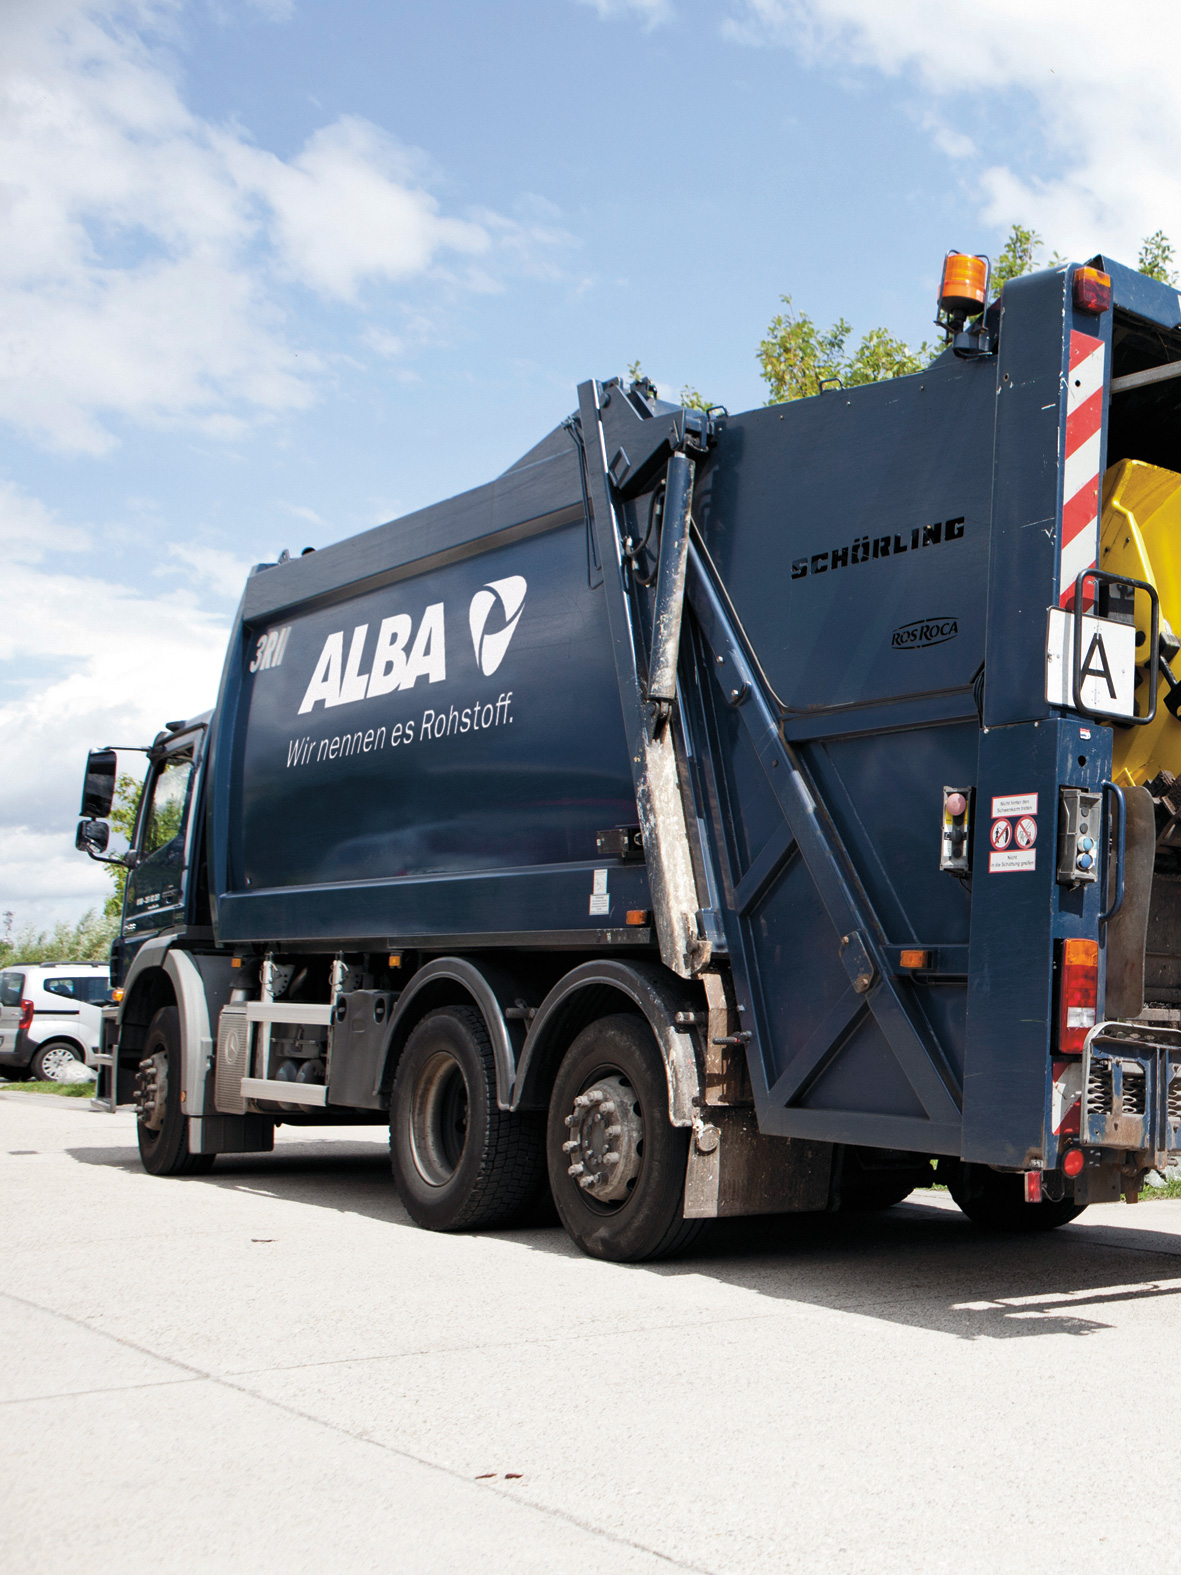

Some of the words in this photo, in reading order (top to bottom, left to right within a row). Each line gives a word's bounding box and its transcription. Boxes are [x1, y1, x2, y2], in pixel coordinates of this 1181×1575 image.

[790, 516, 965, 580] SCHÖRLING
[297, 602, 446, 715] ALBA
[1080, 632, 1118, 700] A
[286, 736, 316, 768] Wir
[316, 726, 387, 762] nennen
[390, 720, 415, 747] es
[419, 691, 514, 741] Rohstoff.
